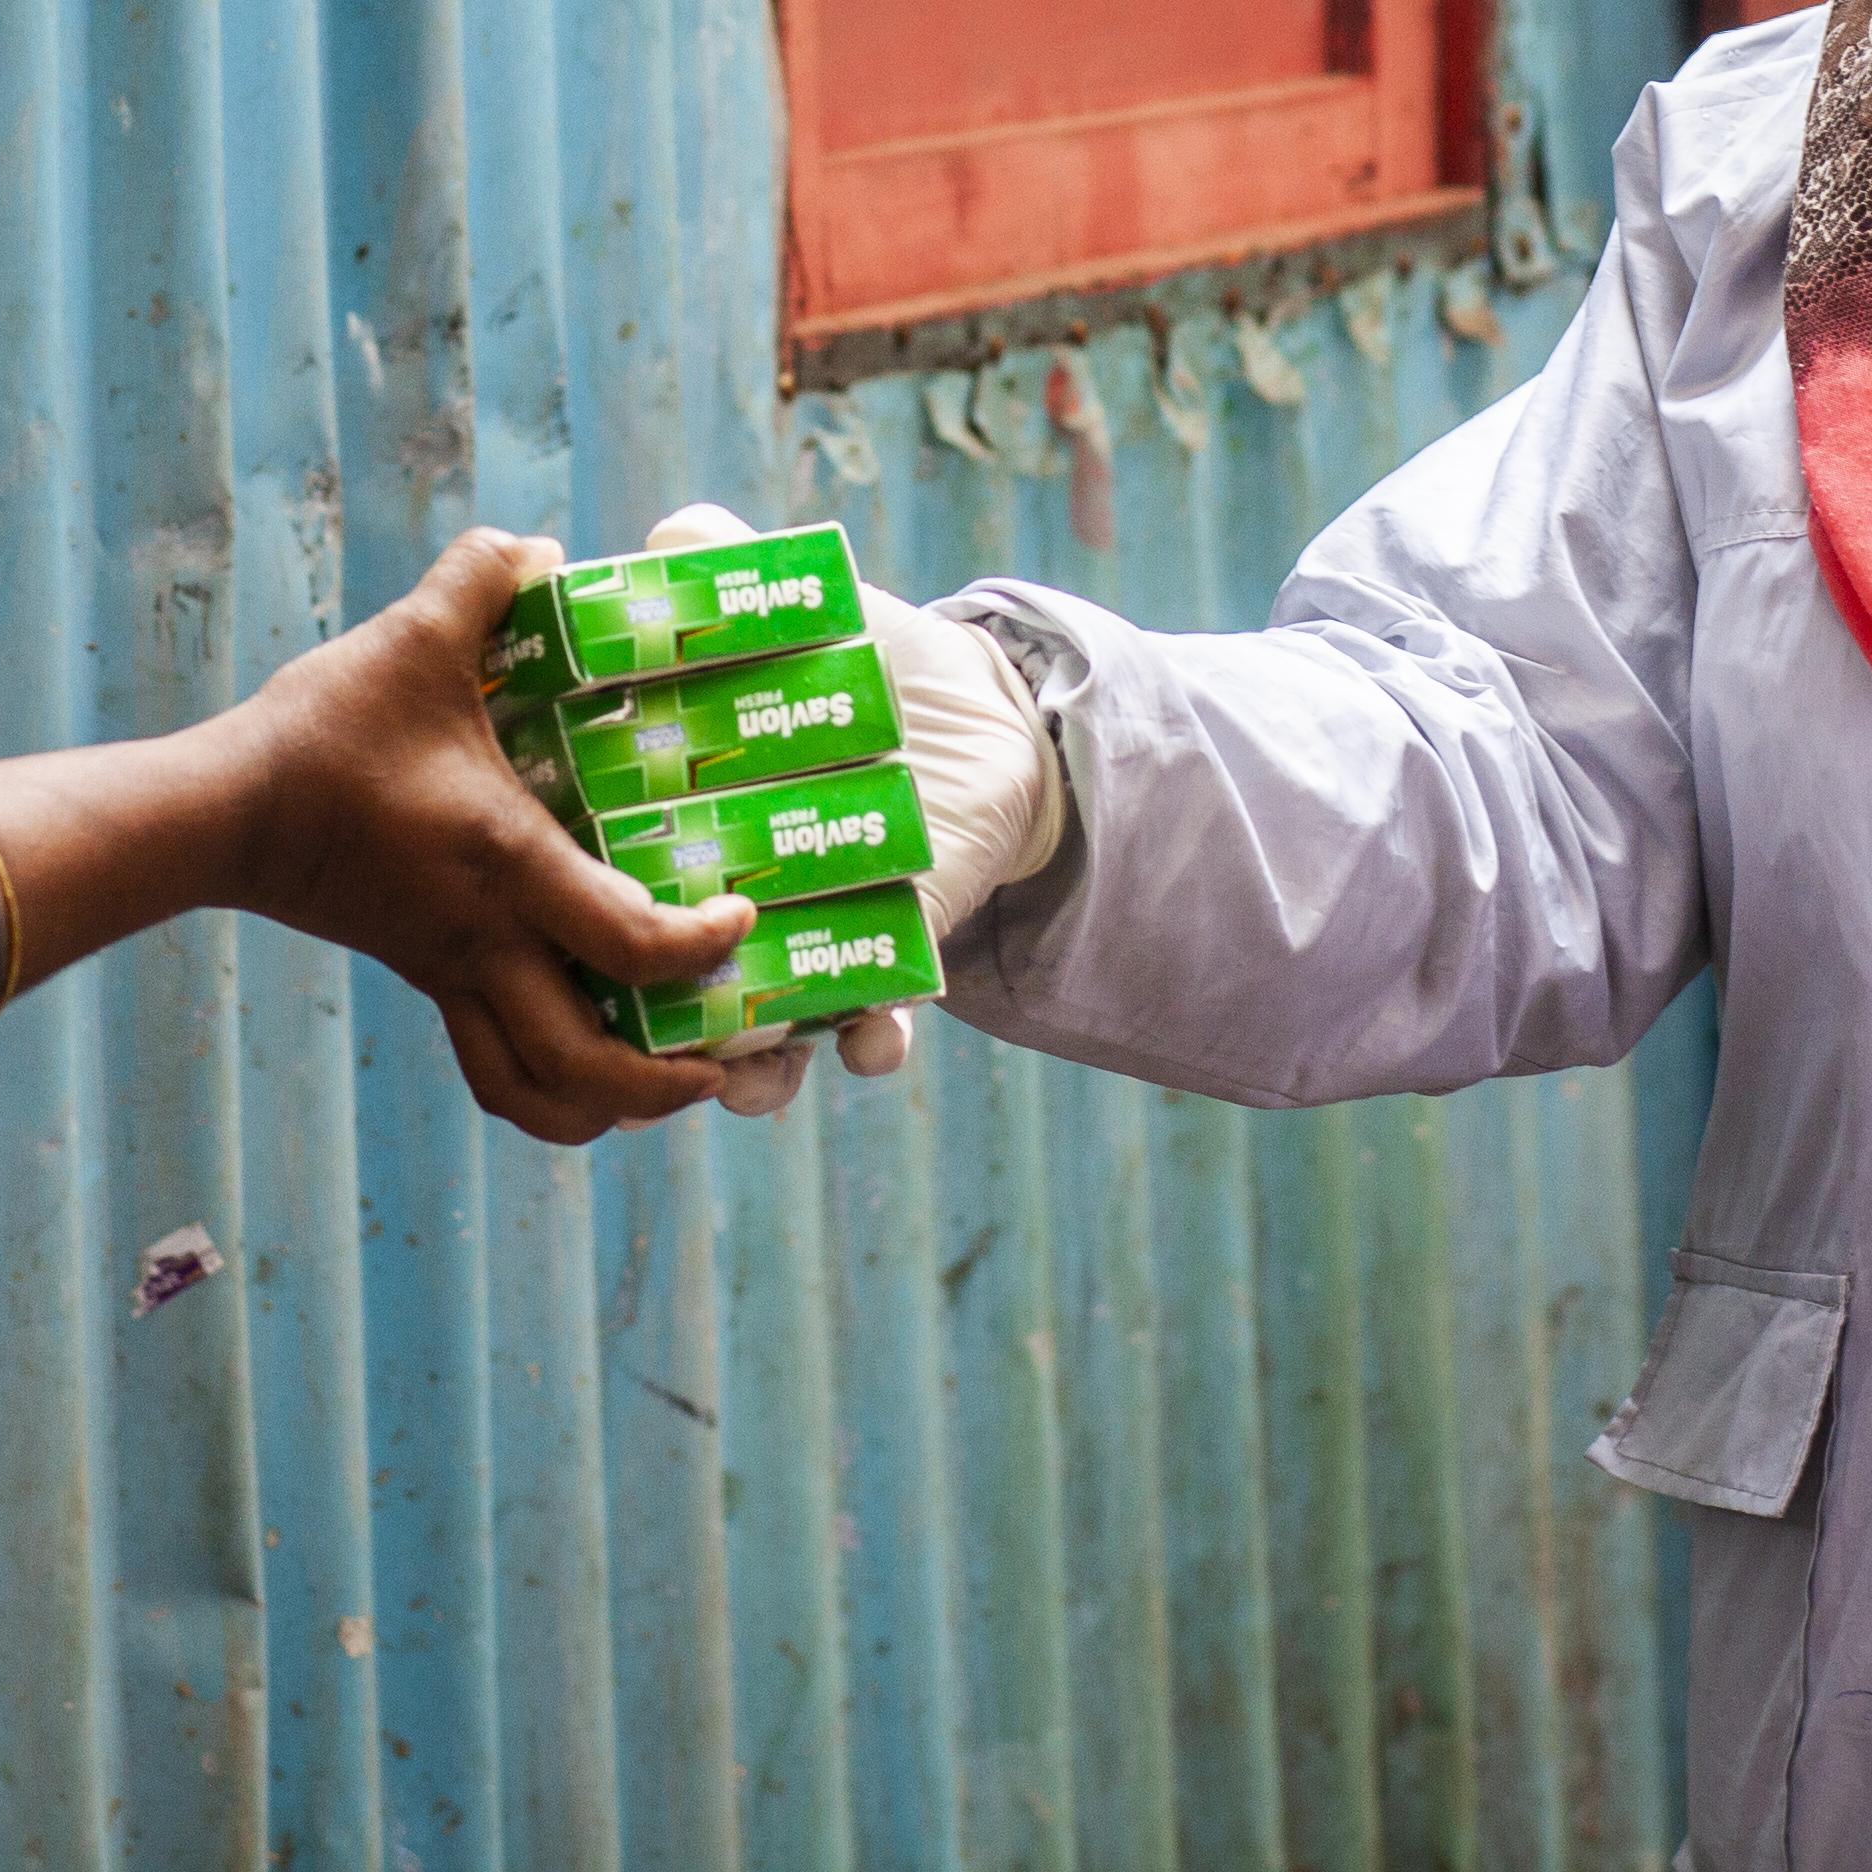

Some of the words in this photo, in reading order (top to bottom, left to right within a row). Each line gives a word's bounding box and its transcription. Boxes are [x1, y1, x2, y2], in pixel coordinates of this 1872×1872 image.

[714, 568, 761, 589] FRESH
[718, 574, 824, 617] Savlon
[734, 688, 784, 712] FRESH
[737, 692, 855, 739] Savlon
[768, 806, 819, 829] FRESH
[772, 811, 887, 858] Savlon
[785, 927, 833, 950] FRESH
[789, 933, 897, 978] Savlon
